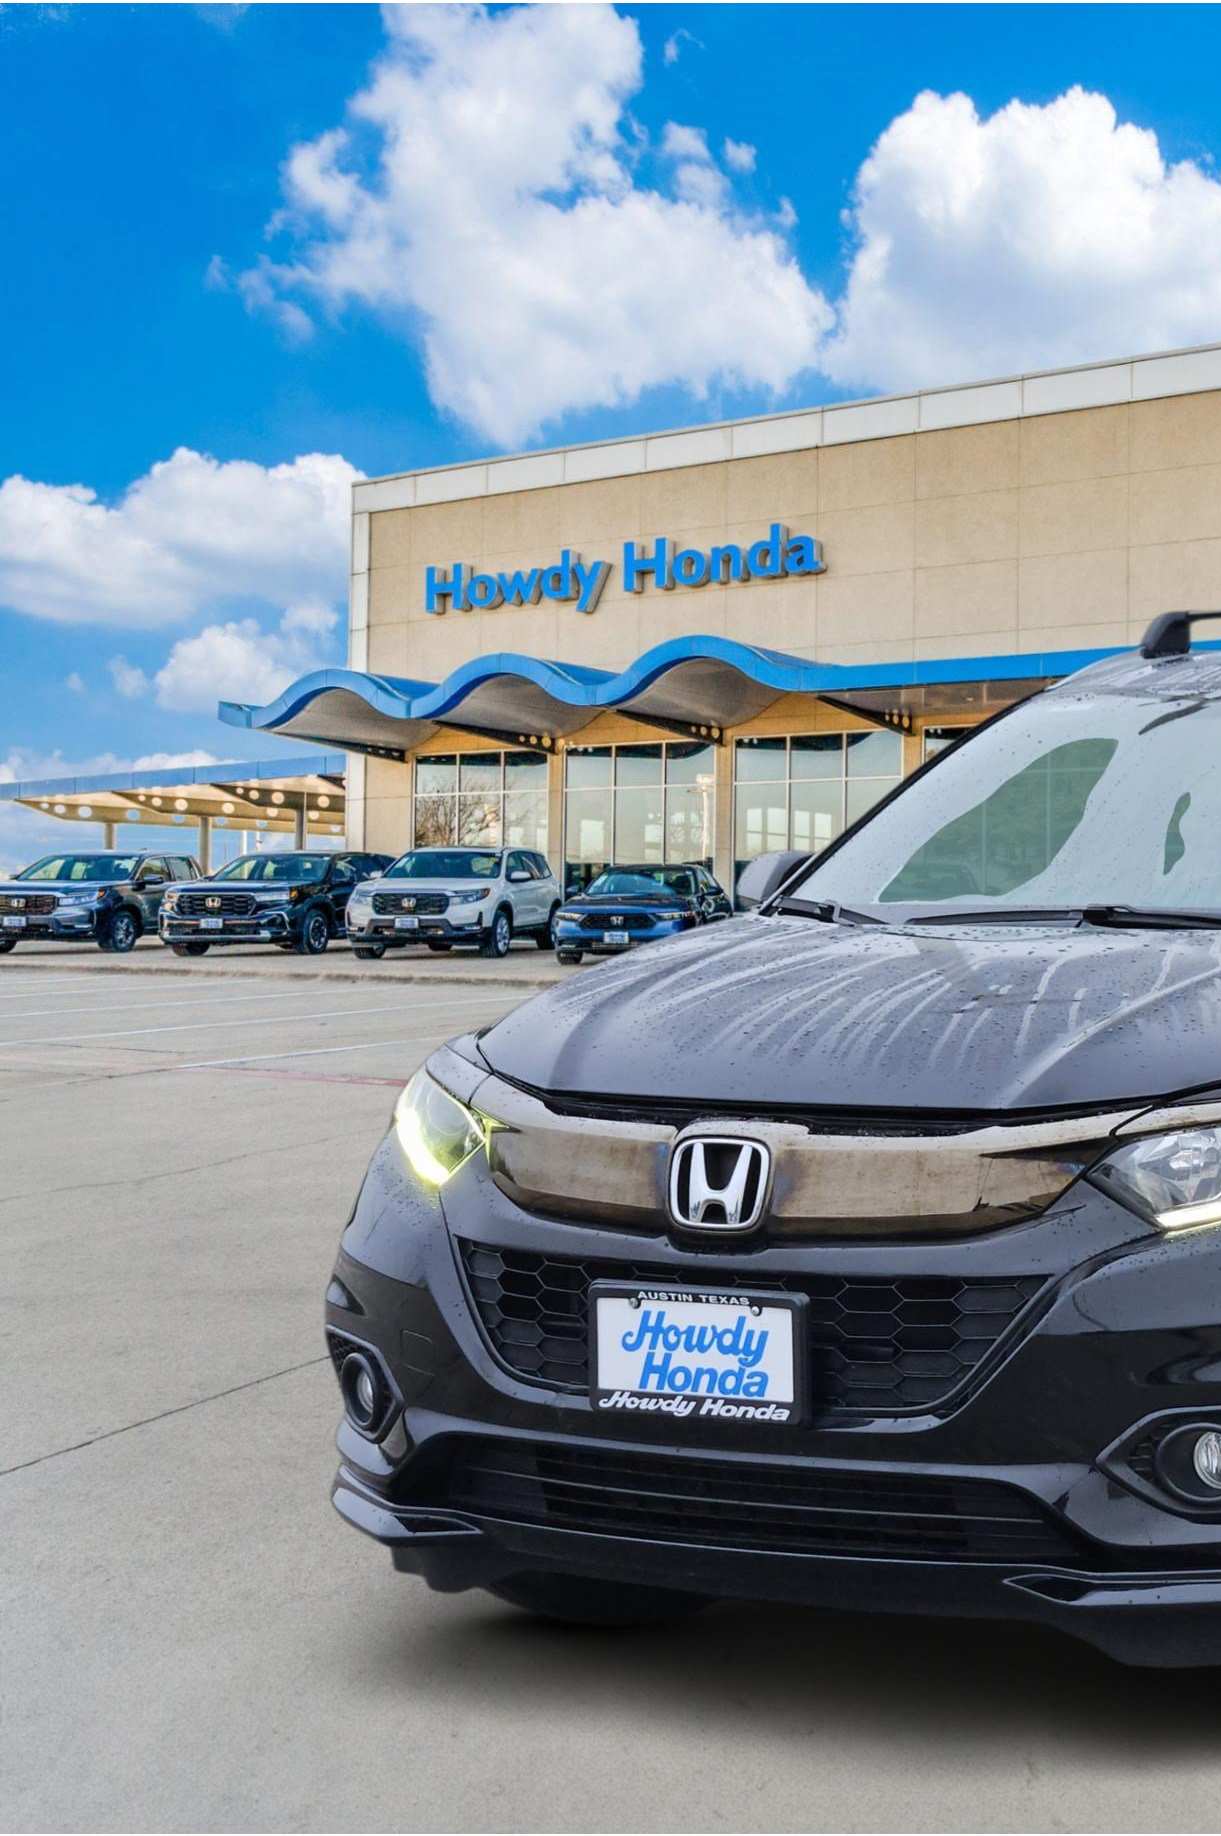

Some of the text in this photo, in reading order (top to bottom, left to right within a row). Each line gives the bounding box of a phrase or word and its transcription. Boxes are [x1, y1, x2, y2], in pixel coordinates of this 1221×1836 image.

[425, 523, 826, 614] Howdy Honda
[637, 1290, 750, 1306] AUSTIN TEXAS
[621, 1310, 769, 1368] Howdy
[638, 1351, 769, 1398] Honda
[598, 1391, 790, 1421] Howdy Honda
